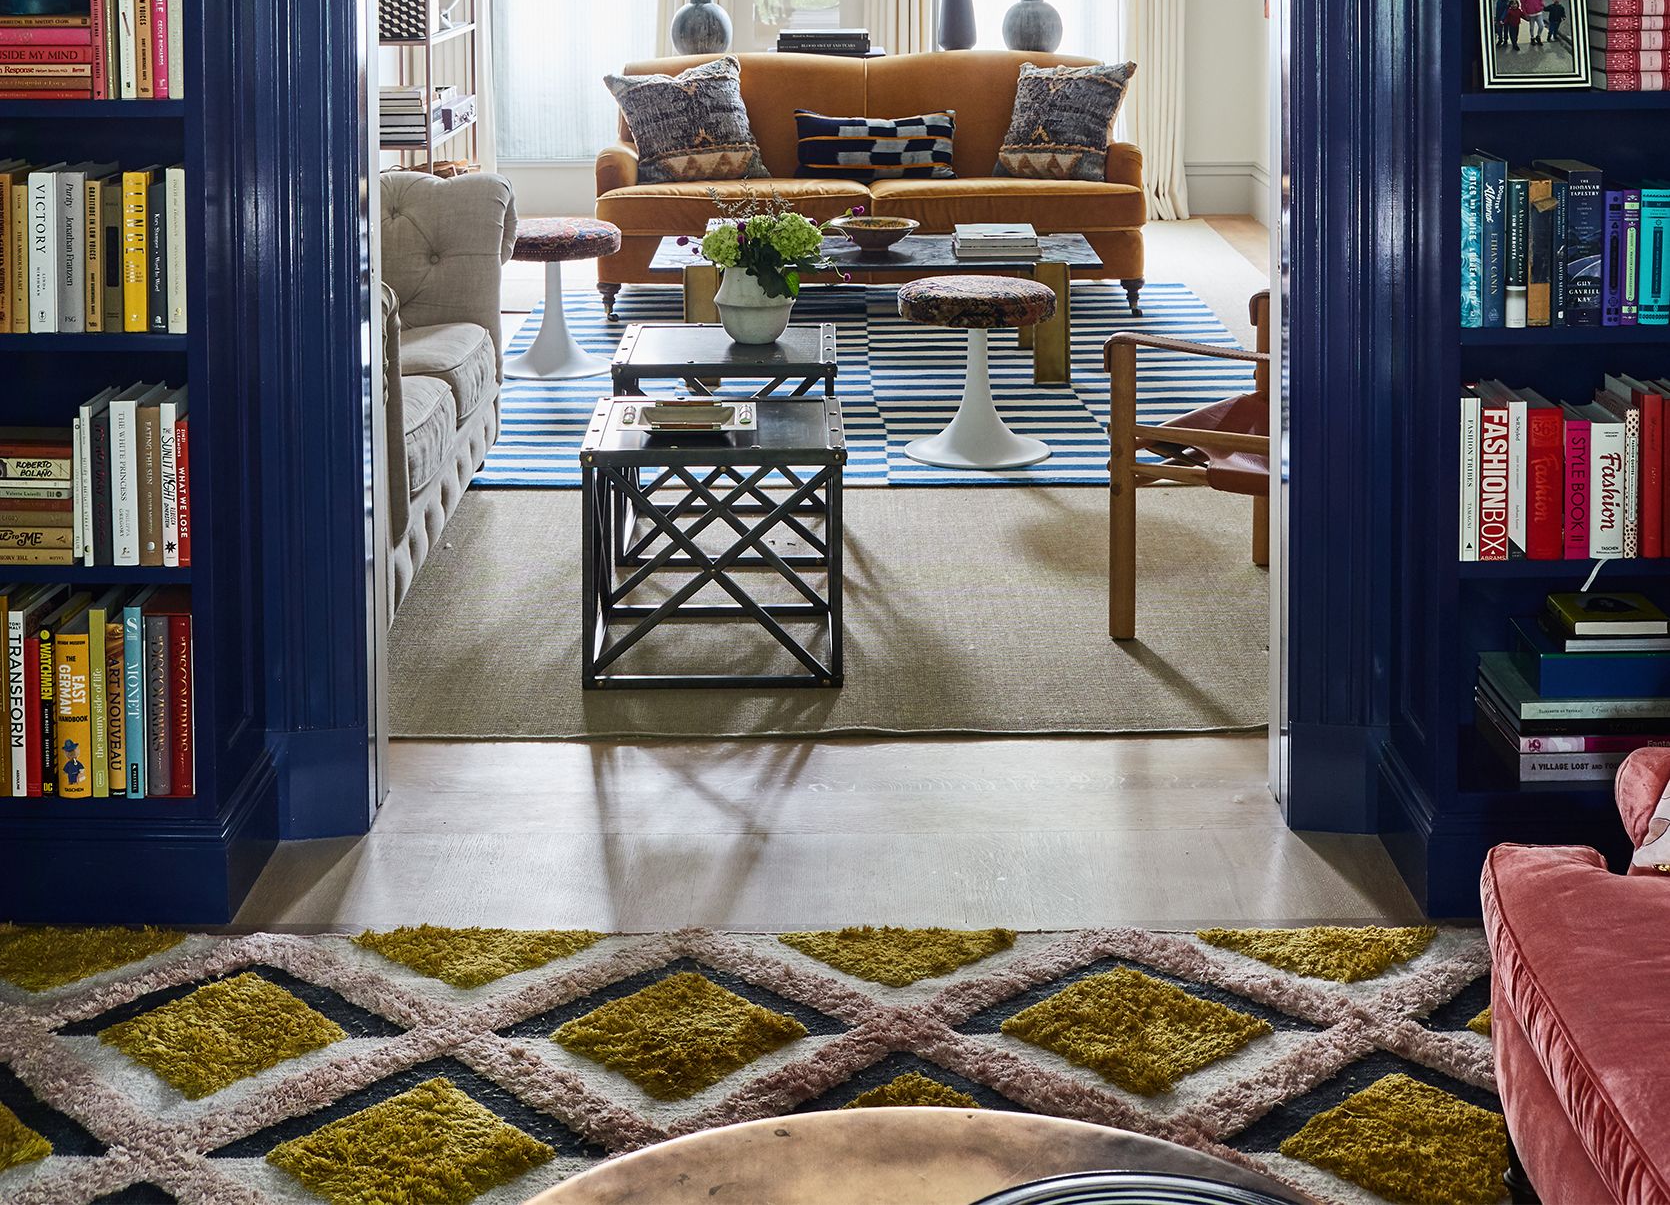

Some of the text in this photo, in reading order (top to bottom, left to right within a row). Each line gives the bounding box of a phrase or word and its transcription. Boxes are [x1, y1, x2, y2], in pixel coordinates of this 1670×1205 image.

[0, 50, 78, 60] SIDE MY MIND
[4, 66, 34, 74] Response
[35, 184, 46, 254] VICTORY
[64, 183, 74, 208] Purity
[88, 186, 96, 217] GRATITUDE
[65, 216, 74, 286] Jonathan Franzen
[64, 315, 76, 323] FSG
[118, 430, 126, 459] WHITE
[144, 421, 152, 450] EATING
[1571, 437, 1586, 478] STYLE
[16, 461, 52, 469] ROBERTO
[20, 469, 53, 477] BOLAÑO
[119, 461, 127, 501] PRINCESS
[161, 435, 176, 503] SUNLIT NIGHT
[1481, 409, 1508, 552] FASHIONBOX
[1530, 454, 1560, 523] Fashion
[178, 466, 188, 538] WHAT WE LOSE
[1570, 483, 1585, 531] BOOK
[1599, 452, 1622, 532] Fashion
[17, 532, 43, 547] ME
[9, 634, 24, 748] TRANSFORM
[40, 642, 53, 700] WATCHMEN
[59, 664, 72, 715] GERMAN
[72, 674, 86, 704] EAST
[126, 662, 140, 720] MONET
[92, 668, 104, 759] the sunny side of life
[108, 657, 122, 771] ART NOUVEAU
[150, 641, 165, 753] DISCOVERERS
[175, 641, 188, 752] DISCOVERERS
[43, 783, 53, 792] DC
